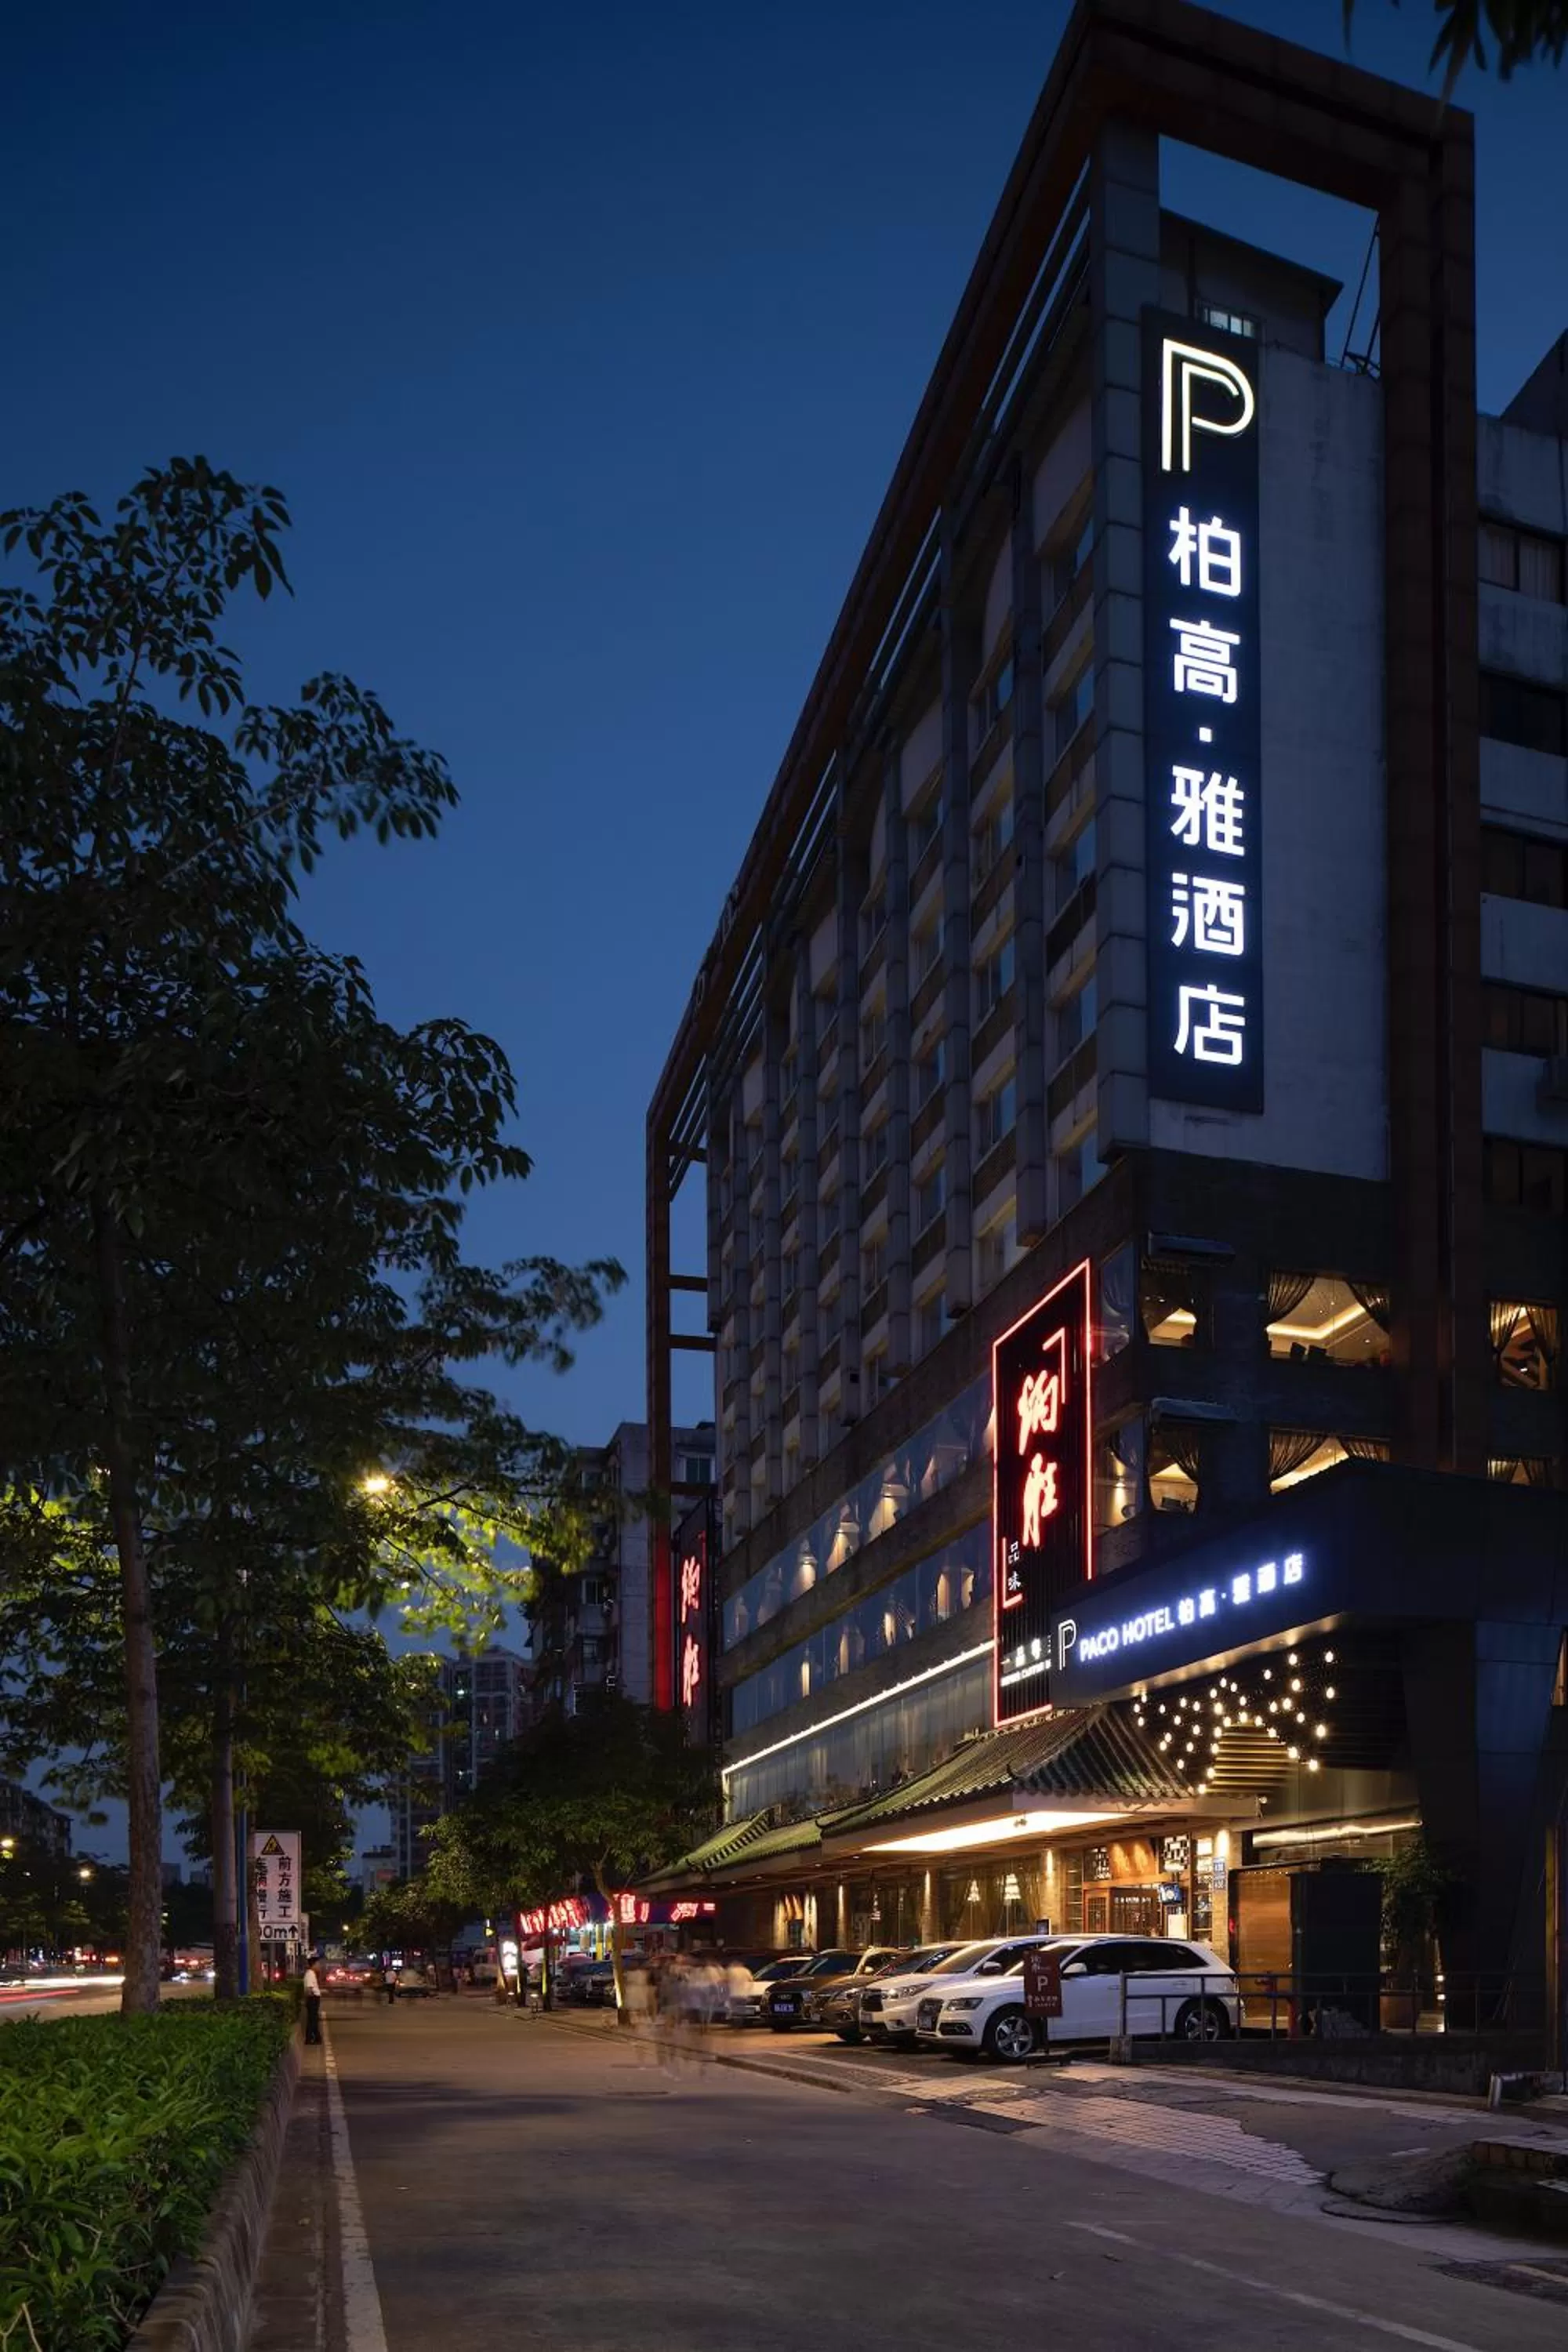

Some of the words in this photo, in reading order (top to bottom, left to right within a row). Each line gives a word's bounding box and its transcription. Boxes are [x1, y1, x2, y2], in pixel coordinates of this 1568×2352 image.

[1161, 337, 1254, 472] P
[1007, 1541, 1022, 1592] 品味
[1079, 1627, 1120, 1663] PACO
[1122, 1606, 1175, 1646] HOTEL
[276, 1856, 292, 1919] 前方施工
[260, 1925, 288, 1939] 0m
[1037, 1976, 1049, 1992] P
